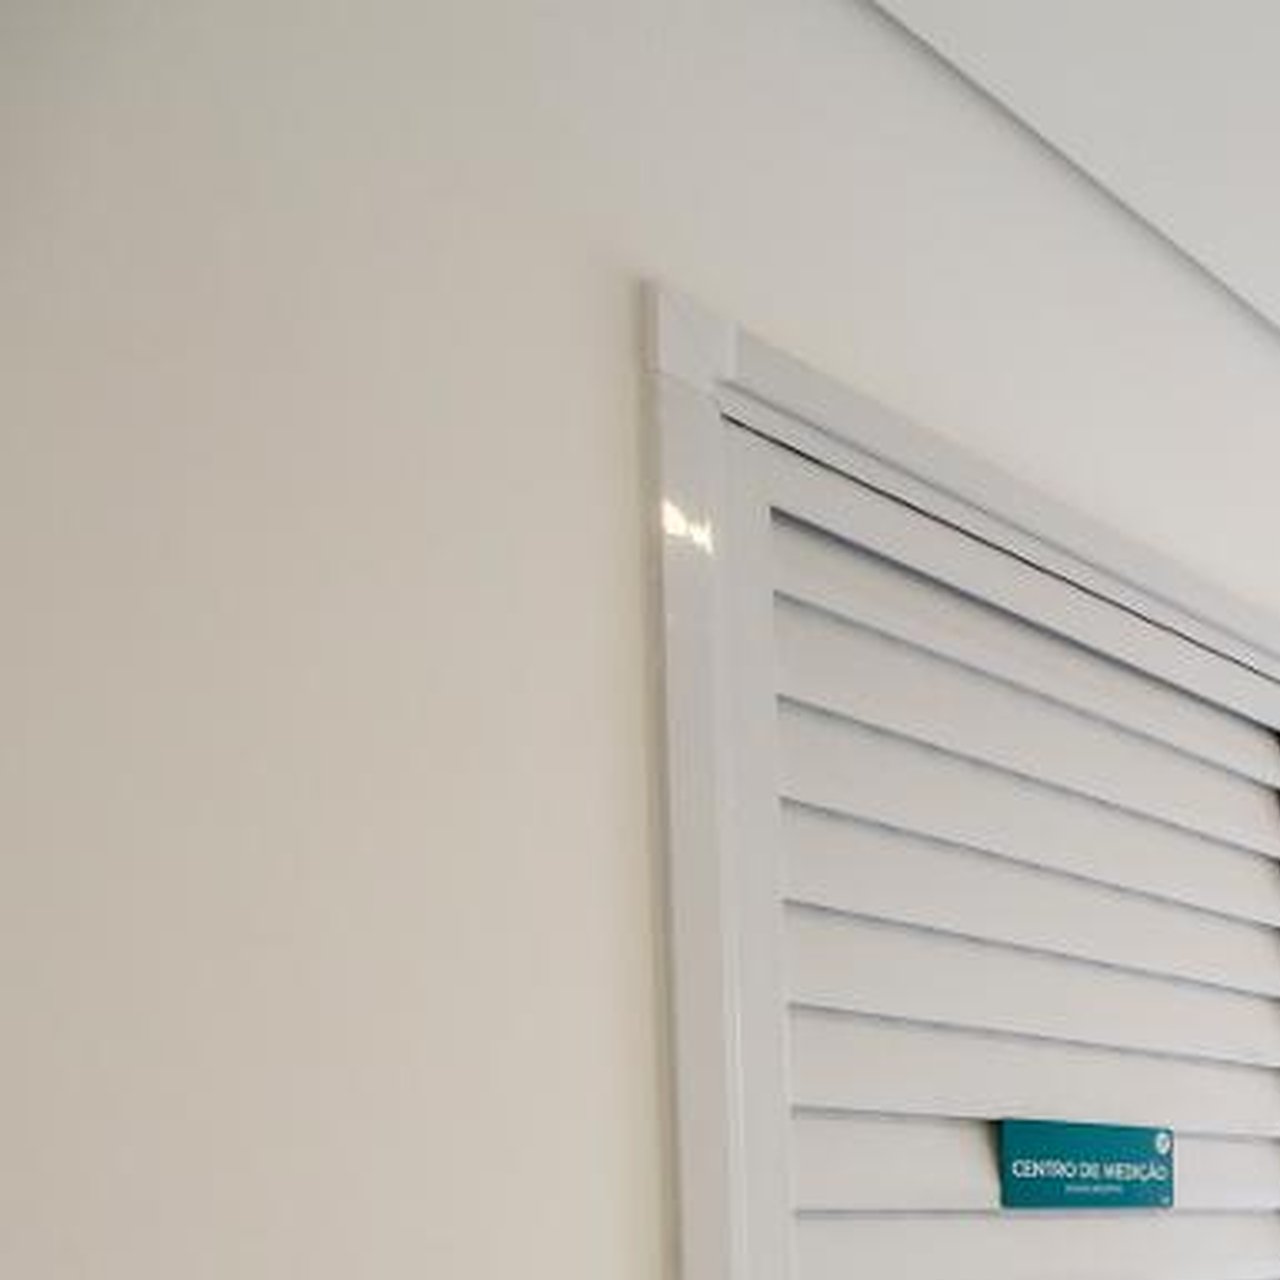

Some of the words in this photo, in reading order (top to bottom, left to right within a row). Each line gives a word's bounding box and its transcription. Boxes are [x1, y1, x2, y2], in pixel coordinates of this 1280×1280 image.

[1012, 1159, 1077, 1179] CENTRO
[1080, 1162, 1099, 1180] DE
[1102, 1160, 1169, 1182] MEDIÇÃO
